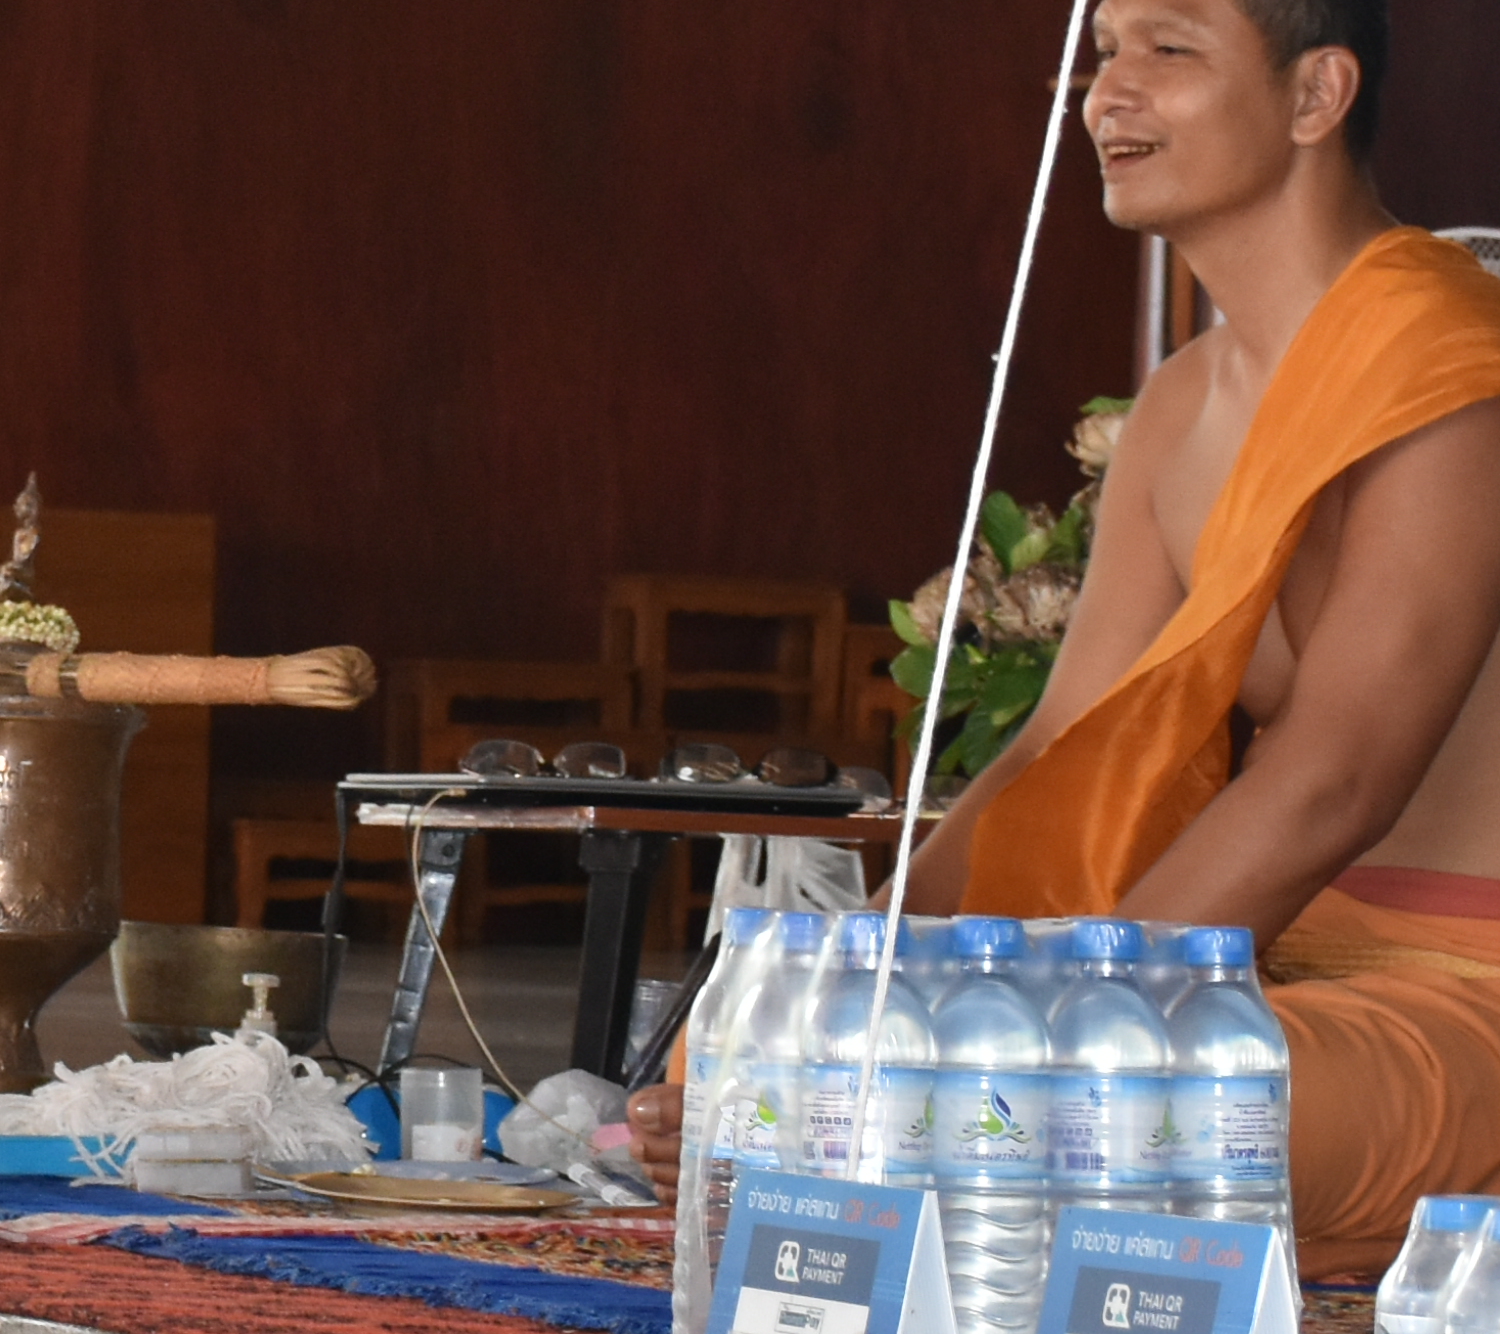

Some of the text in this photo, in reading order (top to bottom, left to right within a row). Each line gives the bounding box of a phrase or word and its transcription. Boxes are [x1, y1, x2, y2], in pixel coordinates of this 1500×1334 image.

[807, 1248, 848, 1268] THAI QR
[802, 1266, 845, 1285] PAYMENT
[1138, 1291, 1184, 1313] THAI QR
[1132, 1311, 1181, 1331] PAYMENT
